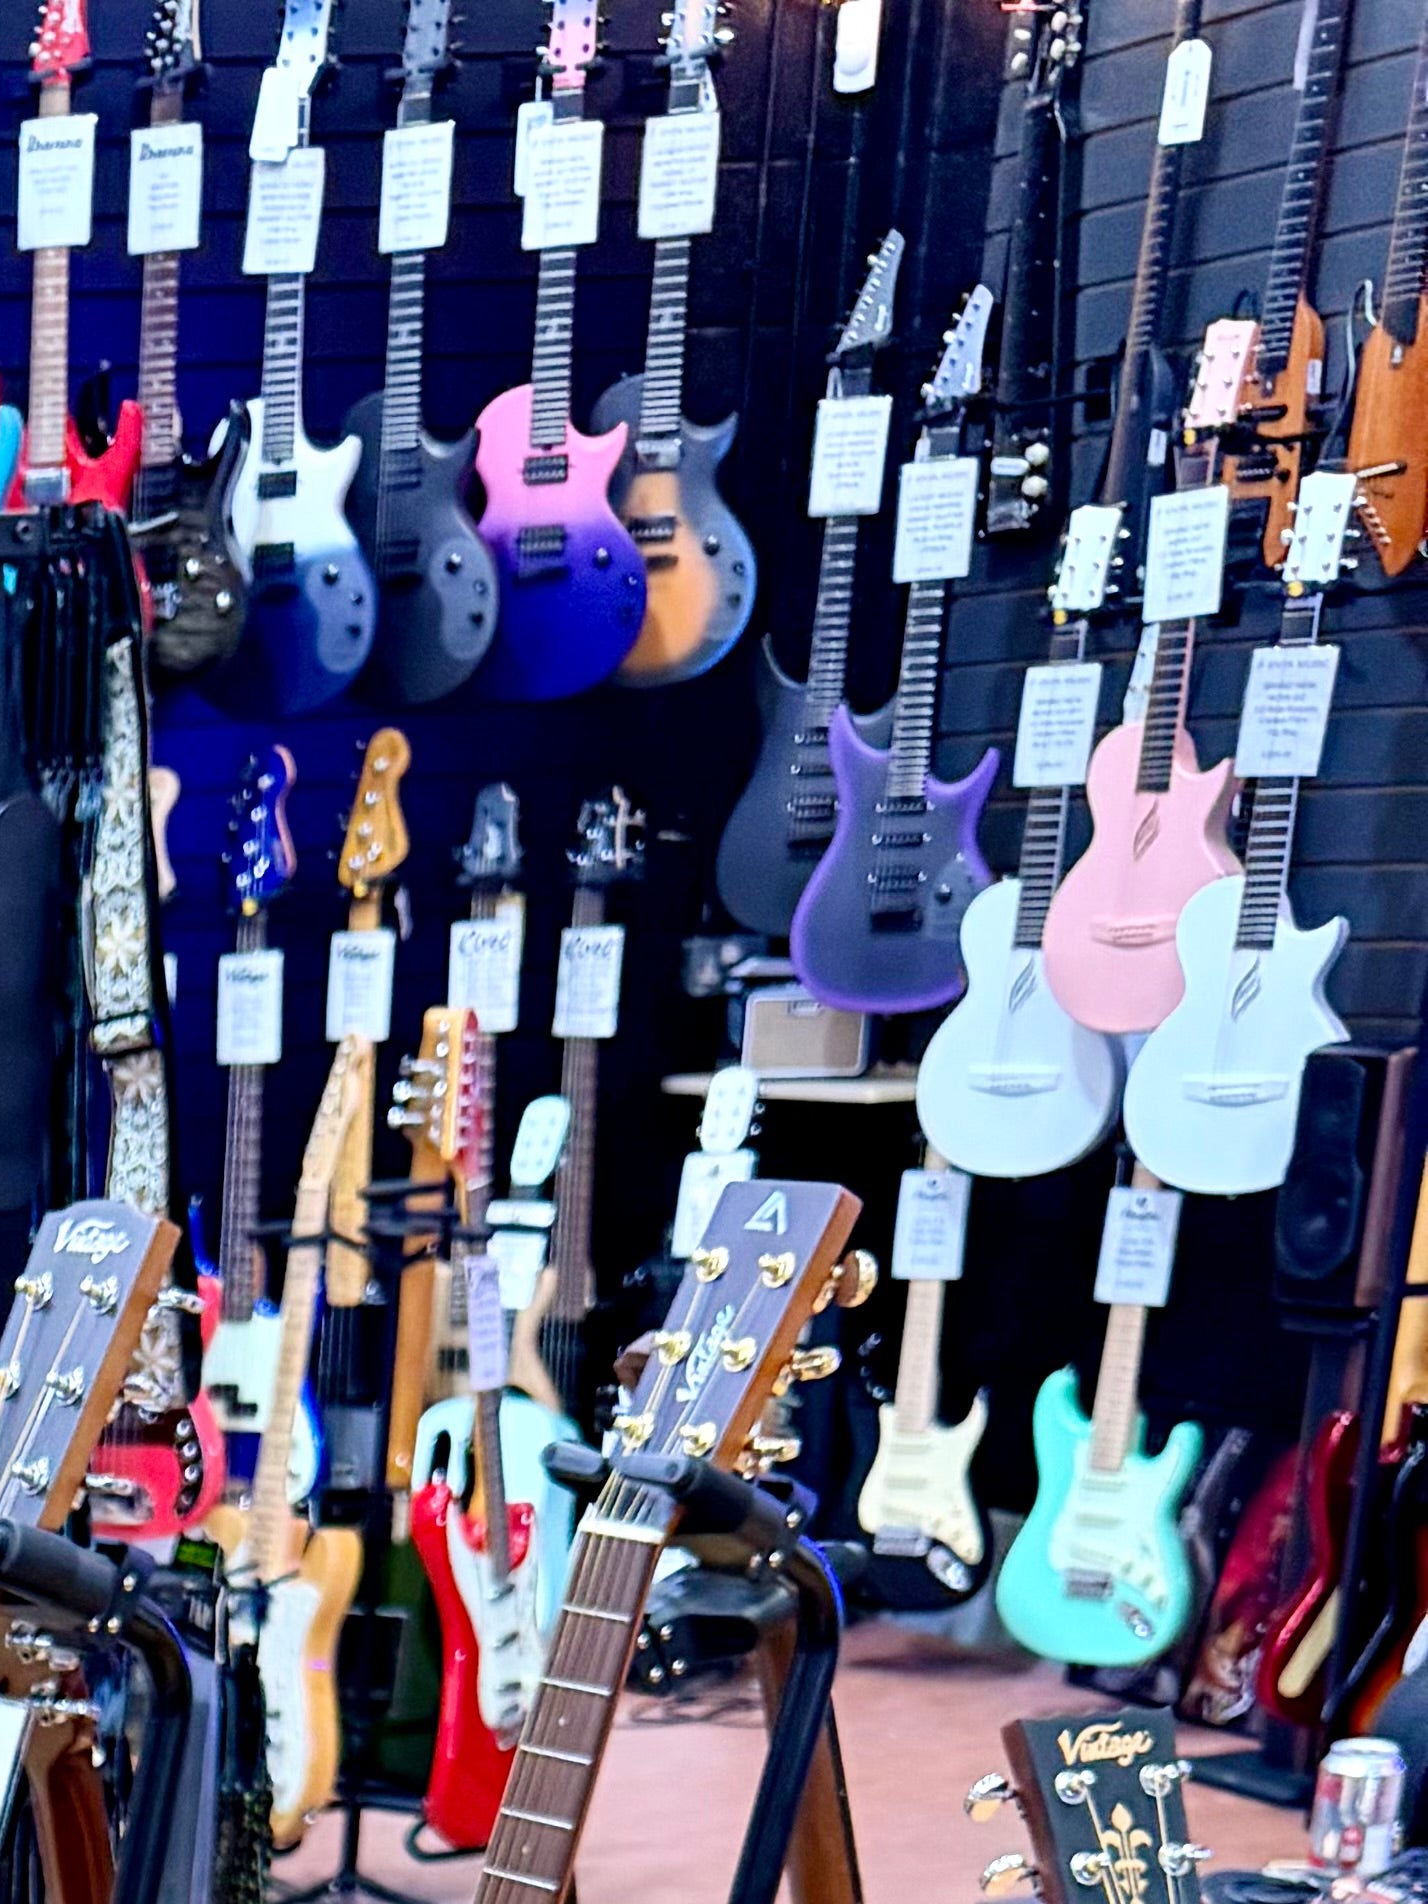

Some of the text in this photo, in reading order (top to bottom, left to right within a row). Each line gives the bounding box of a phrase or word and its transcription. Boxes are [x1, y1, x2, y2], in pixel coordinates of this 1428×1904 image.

[53, 1218, 130, 1265] Vintage
[676, 1303, 736, 1403] Vintage
[1057, 1720, 1154, 1767] Vintage
